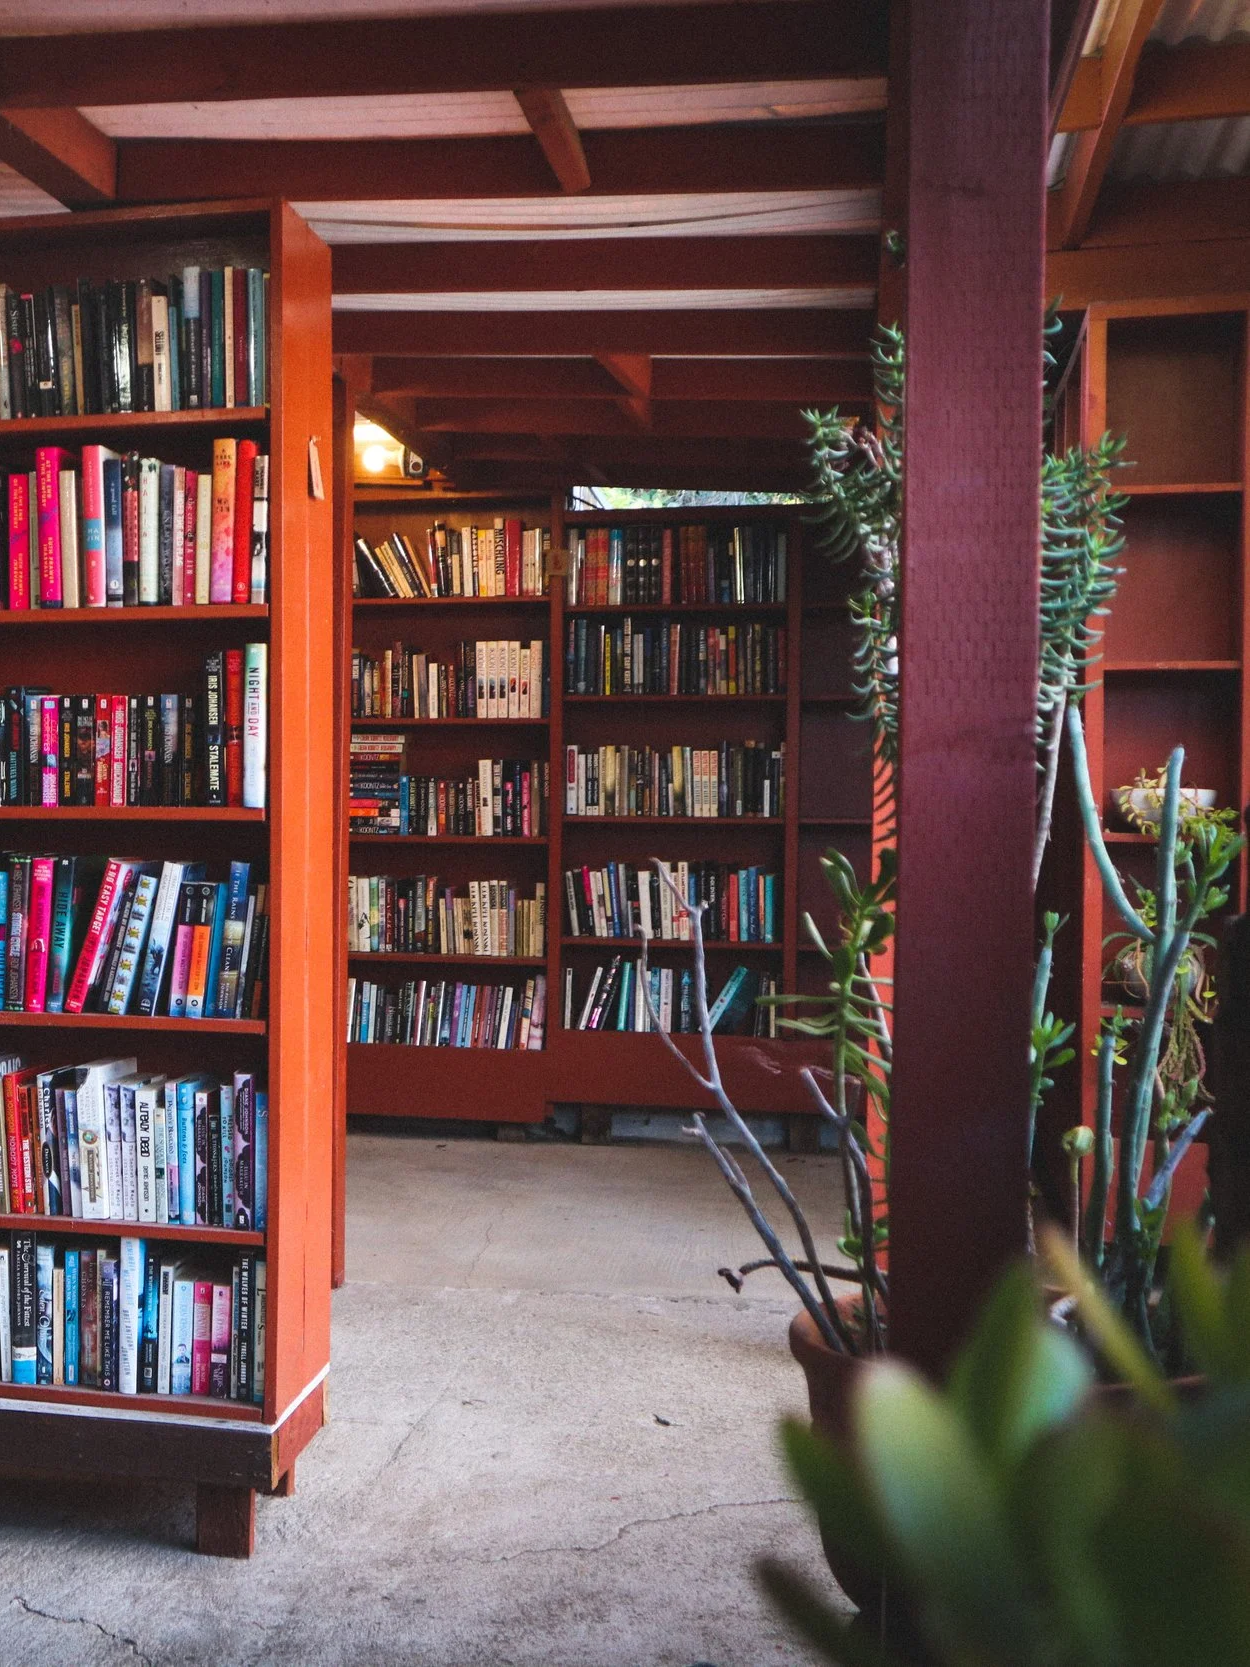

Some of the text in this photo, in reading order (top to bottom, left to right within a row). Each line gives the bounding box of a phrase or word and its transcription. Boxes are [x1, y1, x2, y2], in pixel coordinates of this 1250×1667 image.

[11, 310, 20, 336] Sister
[175, 490, 184, 567] UNDER THE RED FLAG
[186, 498, 195, 574] the crazed HA JIN
[494, 528, 504, 575] MISCHLING
[248, 667, 260, 700] NIGHT
[208, 676, 219, 790] IRIS JOHANSEN STALEMATE
[248, 718, 260, 738] DAY
[232, 880, 240, 894] THE
[91, 870, 116, 936] NO EASY TARGET
[230, 897, 240, 920] RAINS
[54, 892, 68, 950] HIDE AWAY
[223, 946, 232, 979] CLEANSE
[24, 1151, 32, 1178] WESTERN
[24, 1239, 32, 1252] The
[23, 1253, 34, 1286] Survival
[240, 1272, 248, 1296] WOLVES
[24, 1294, 32, 1305] the
[24, 1306, 32, 1327] Fittest
[240, 1306, 248, 1330] WINTER
[104, 1331, 110, 1340] ME
